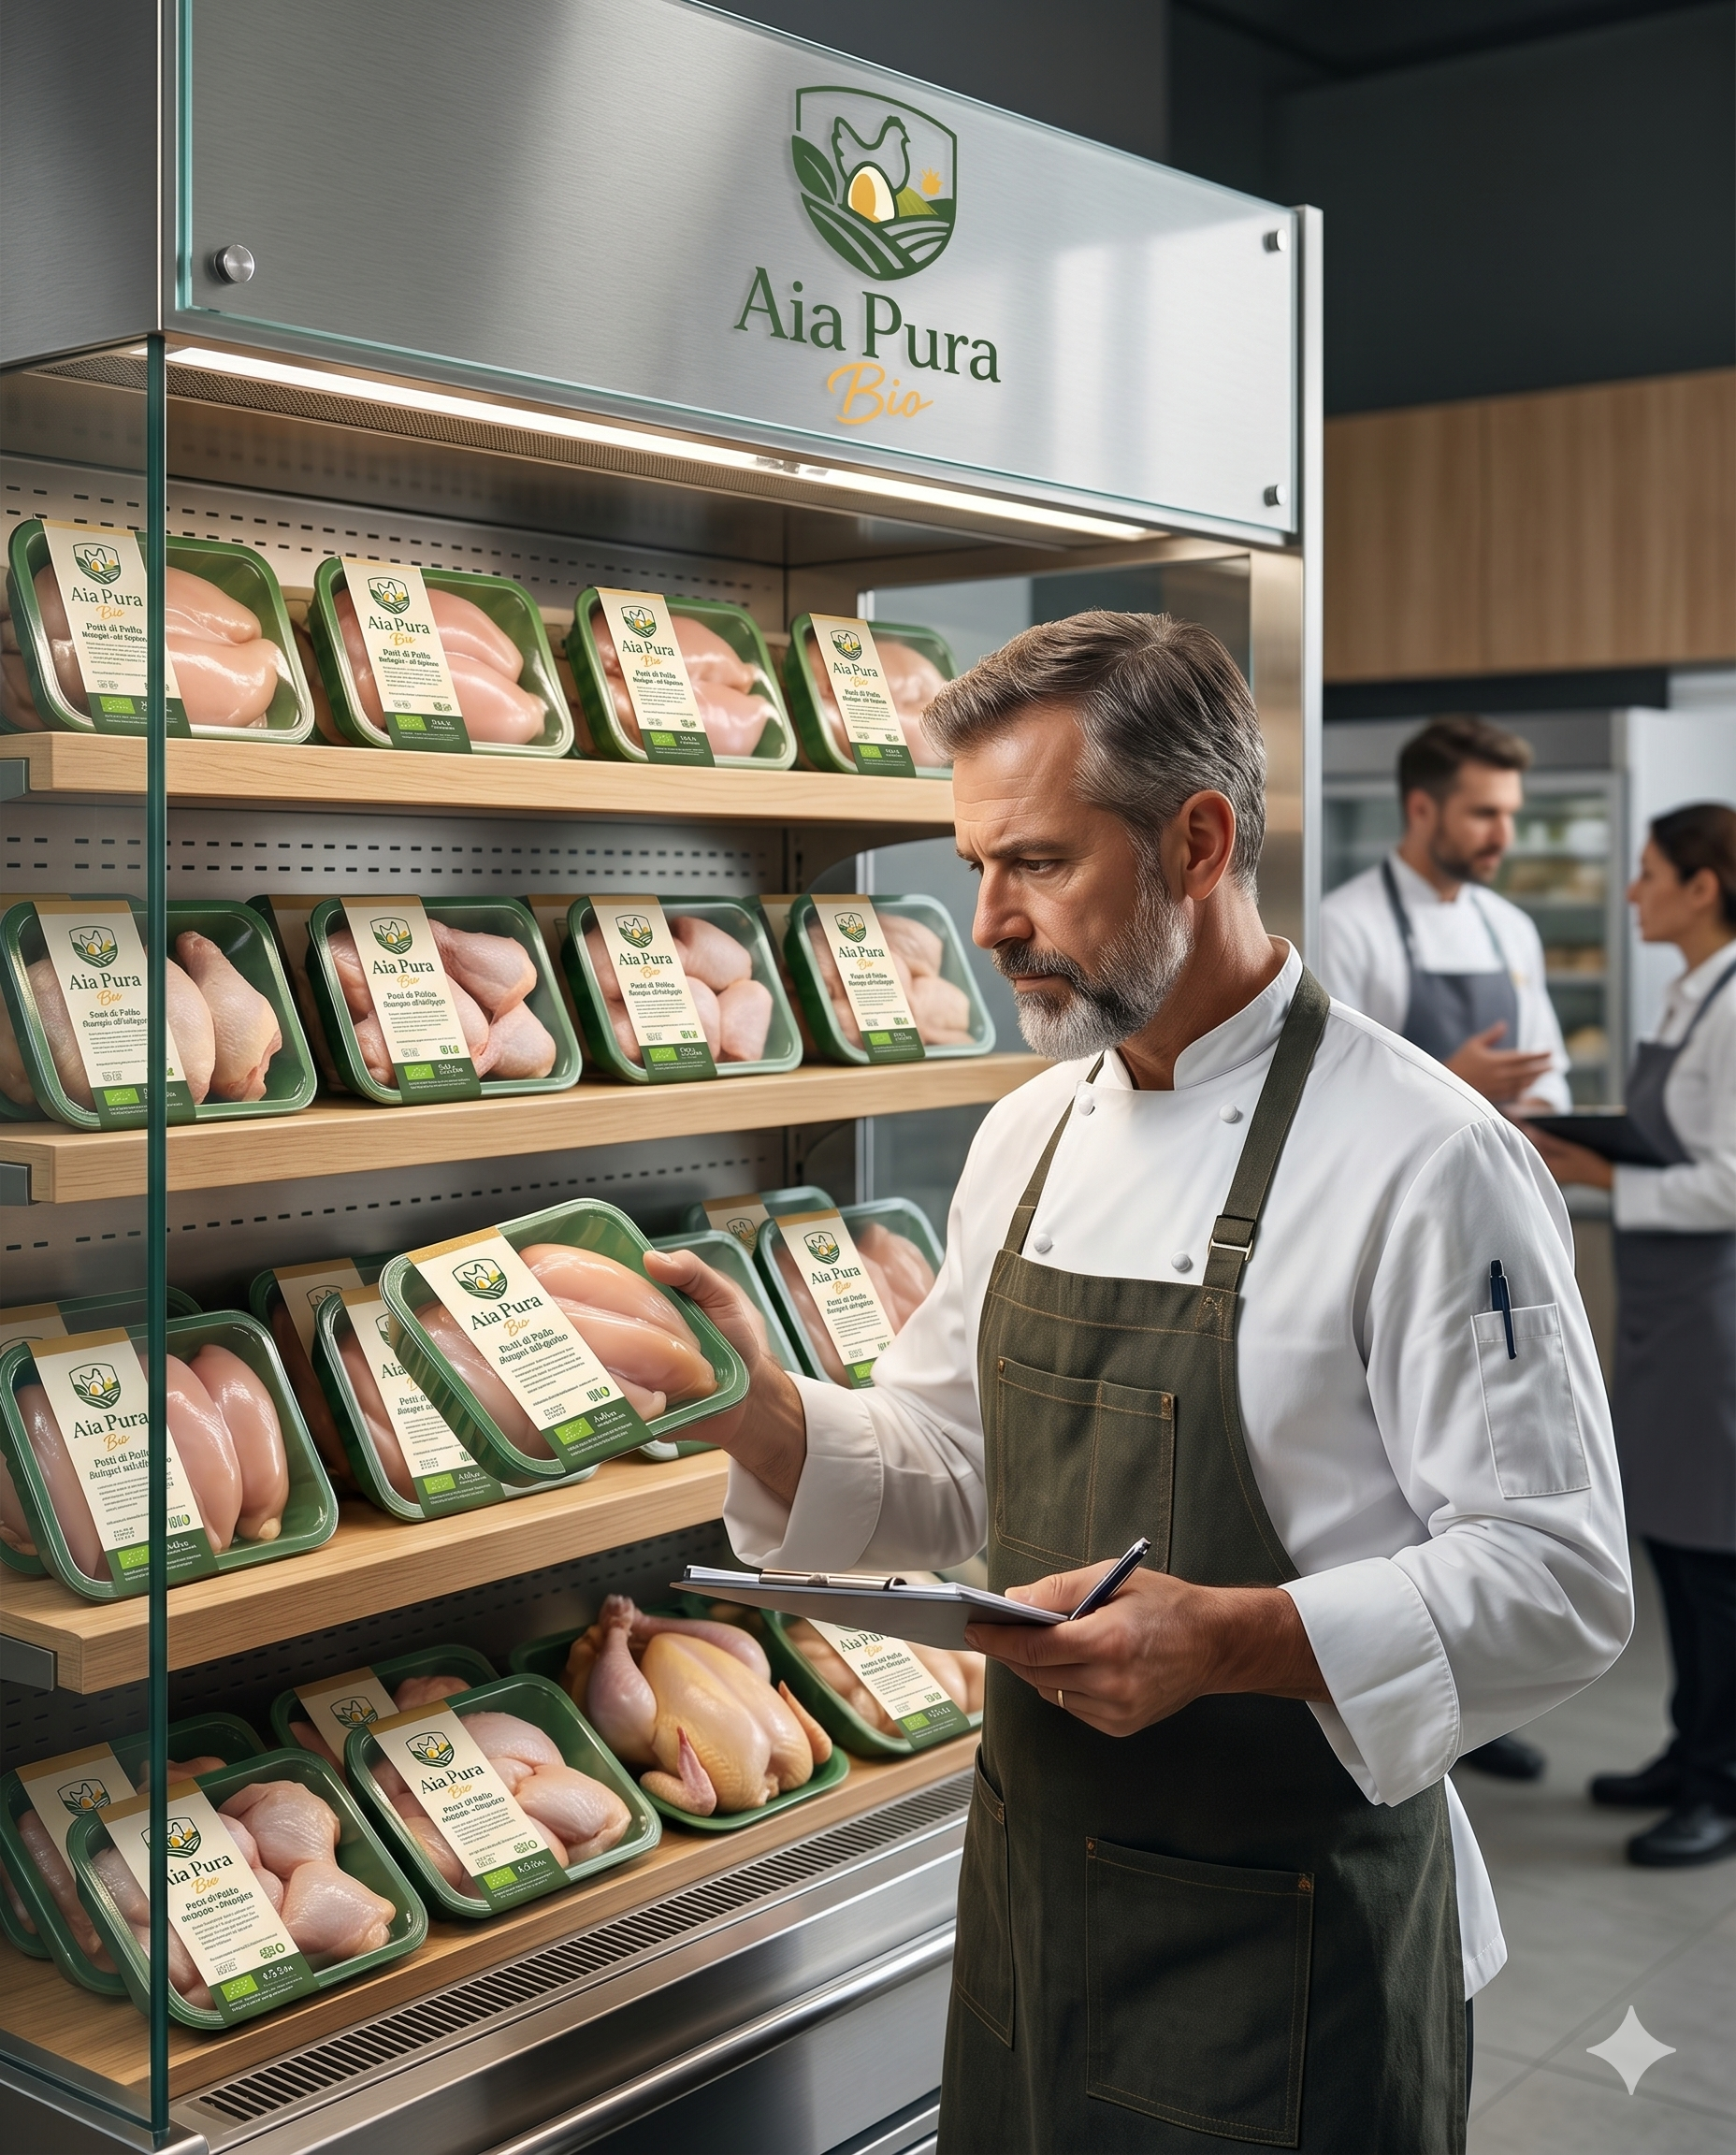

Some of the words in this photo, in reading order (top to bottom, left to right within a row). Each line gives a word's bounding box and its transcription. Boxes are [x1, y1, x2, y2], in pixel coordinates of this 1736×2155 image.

[733, 266, 846, 352] Aia
[861, 291, 1001, 383] Pura
[827, 361, 933, 425] Bio
[71, 586, 99, 603] Aia
[101, 588, 143, 607] Pura
[96, 605, 124, 621] Bio
[369, 615, 393, 630] Aia
[394, 617, 430, 634] Pura
[622, 640, 643, 654] Aia
[644, 642, 674, 656] Pura
[833, 662, 852, 675] Aia
[852, 663, 878, 677] Pura
[619, 953, 641, 965] Aia
[641, 952, 673, 964] Pura
[839, 947, 857, 958] Aia
[857, 946, 885, 957] Pura
[372, 960, 398, 975] Aia
[398, 959, 435, 974] Pura
[69, 974, 99, 991] Aia
[99, 972, 142, 988] Pura
[810, 1269, 832, 1285] Aia
[831, 1265, 861, 1280] Pura
[470, 1311, 501, 1330] Aia
[497, 1295, 543, 1319] Pura
[381, 1363, 406, 1379] Aia
[73, 1420, 105, 1439] Aia
[106, 1411, 150, 1433] Pura
[118, 1454, 127, 1463] di
[840, 1640, 862, 1653] Aia
[420, 1778, 447, 1795] Aia
[445, 1764, 485, 1785] Pura
[167, 1868, 191, 1887] ia
[188, 1854, 235, 1878] Pura
